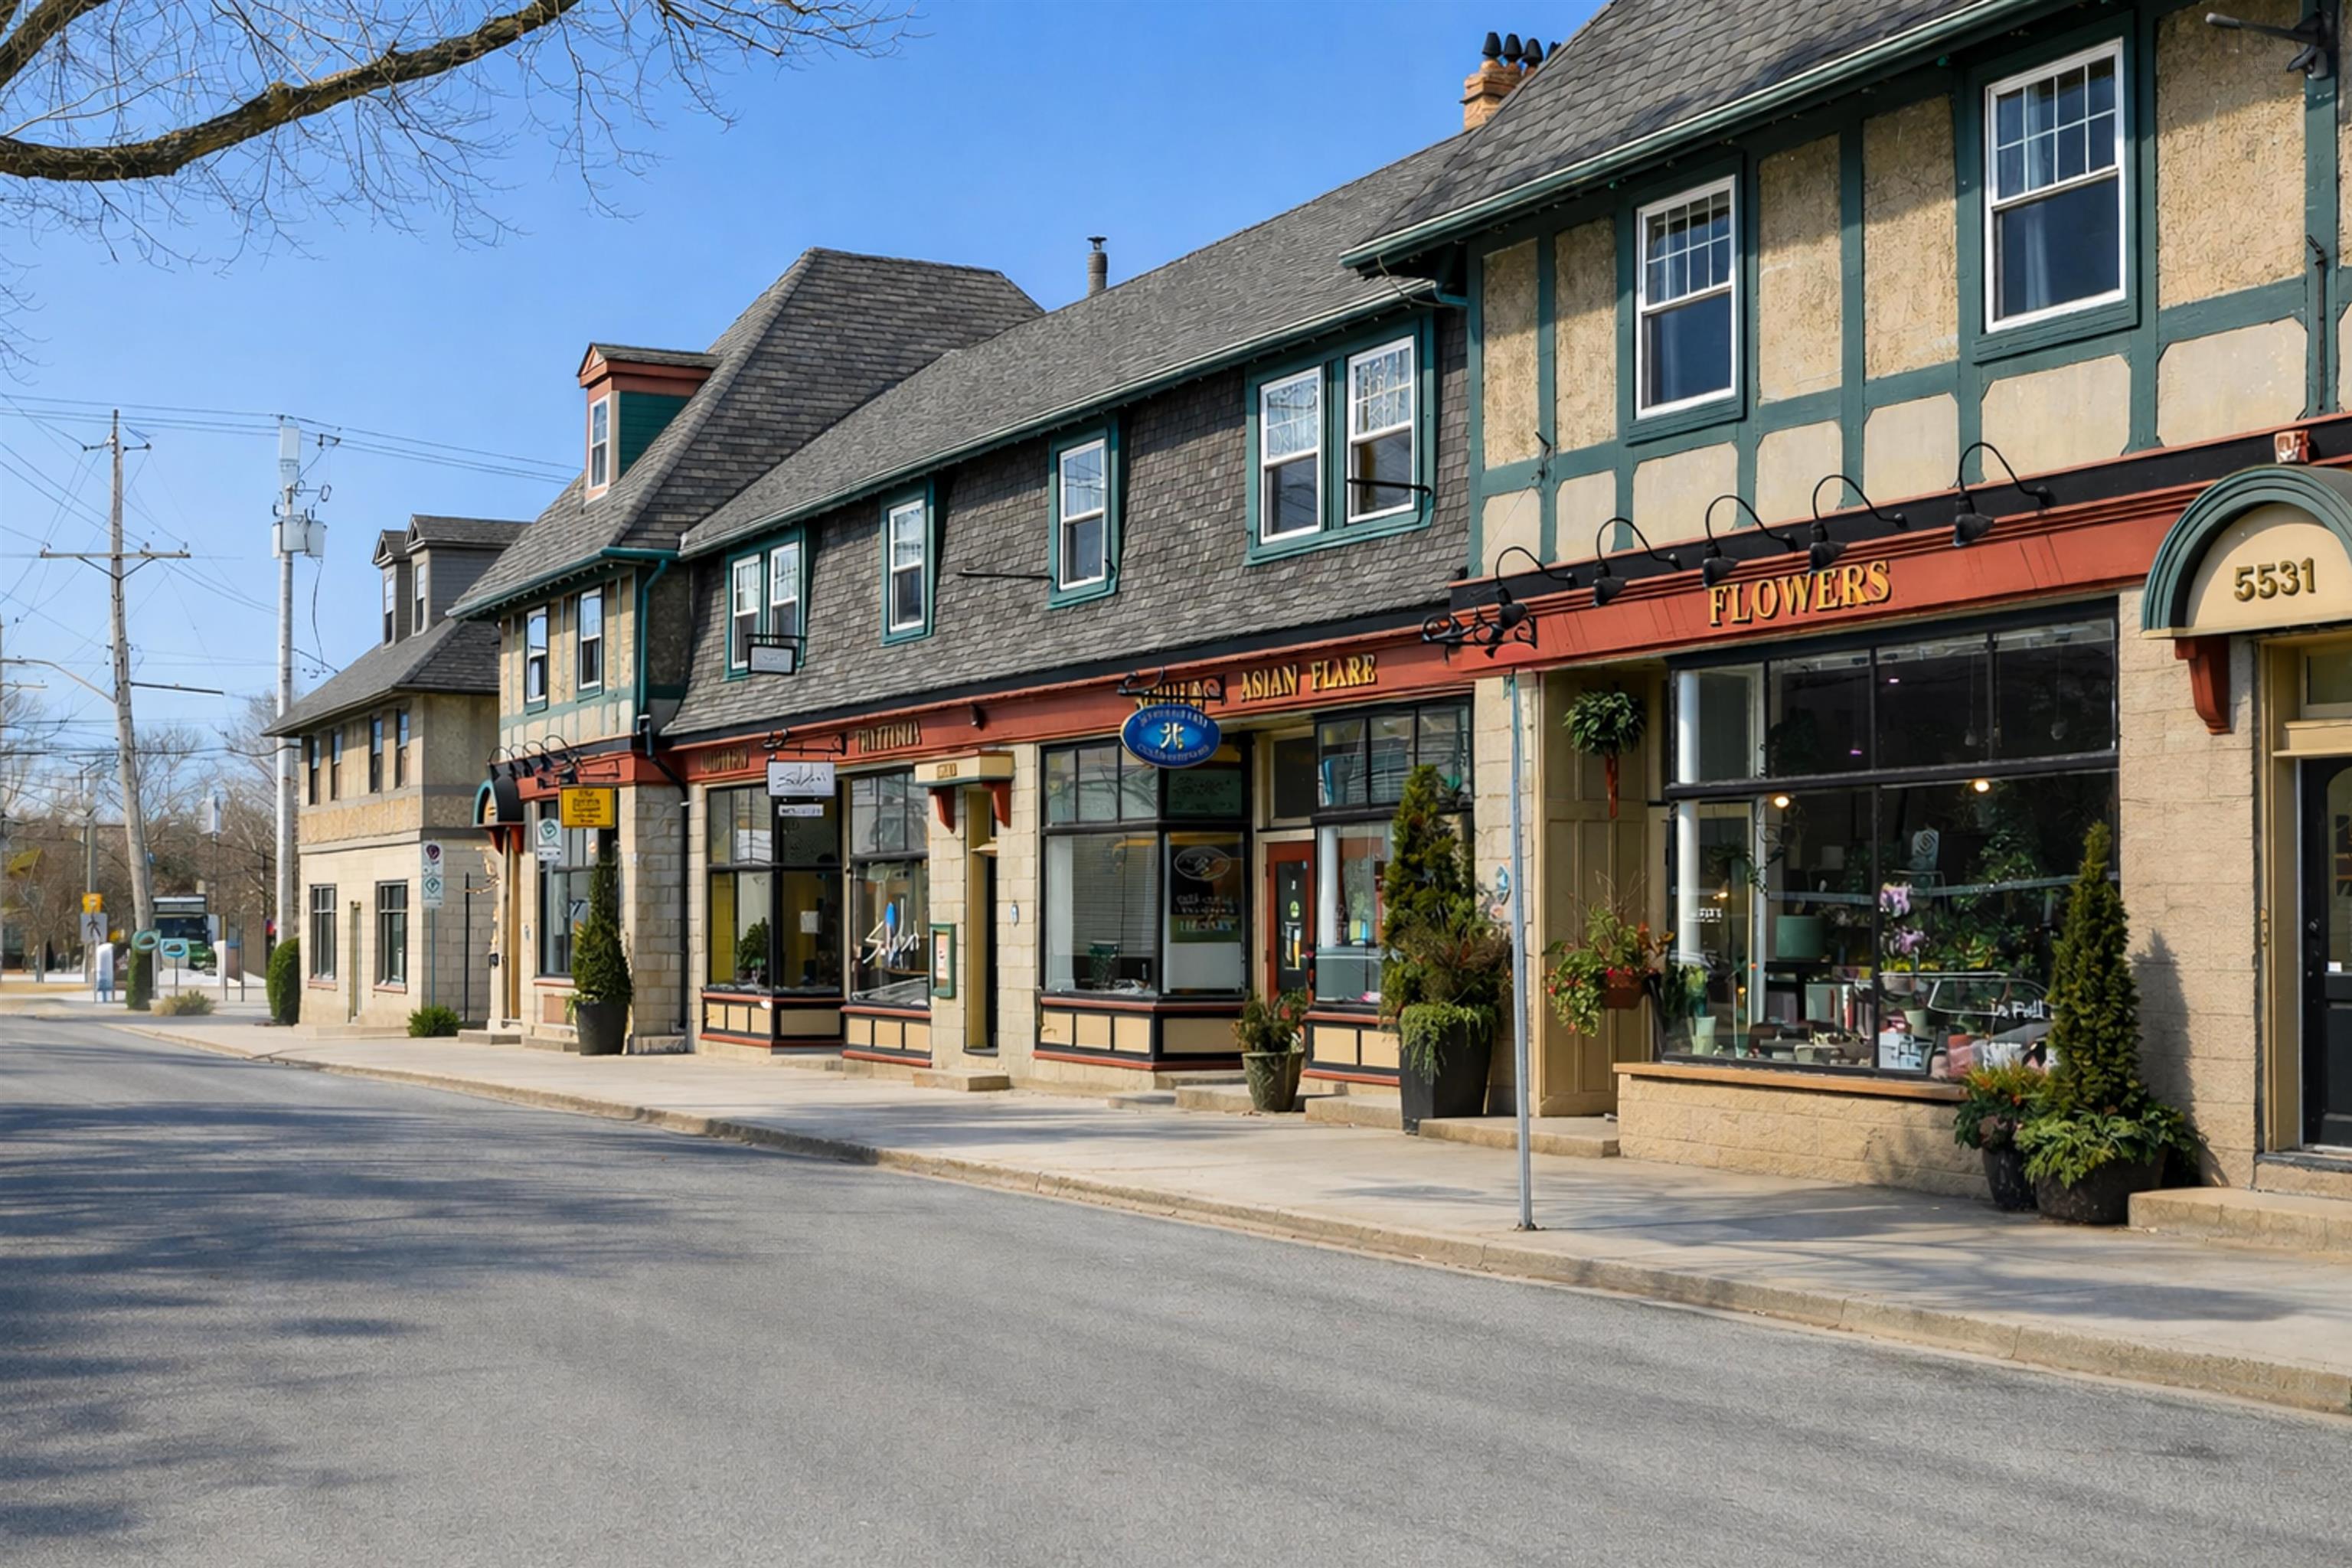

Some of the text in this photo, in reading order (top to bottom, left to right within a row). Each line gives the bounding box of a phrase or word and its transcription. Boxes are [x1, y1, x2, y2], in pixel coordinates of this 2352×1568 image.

[1707, 560, 1891, 626] FLOWERS
[2233, 557, 2315, 603] 5531
[1241, 664, 1298, 702] ASIAN
[1310, 654, 1377, 691] FLARE
